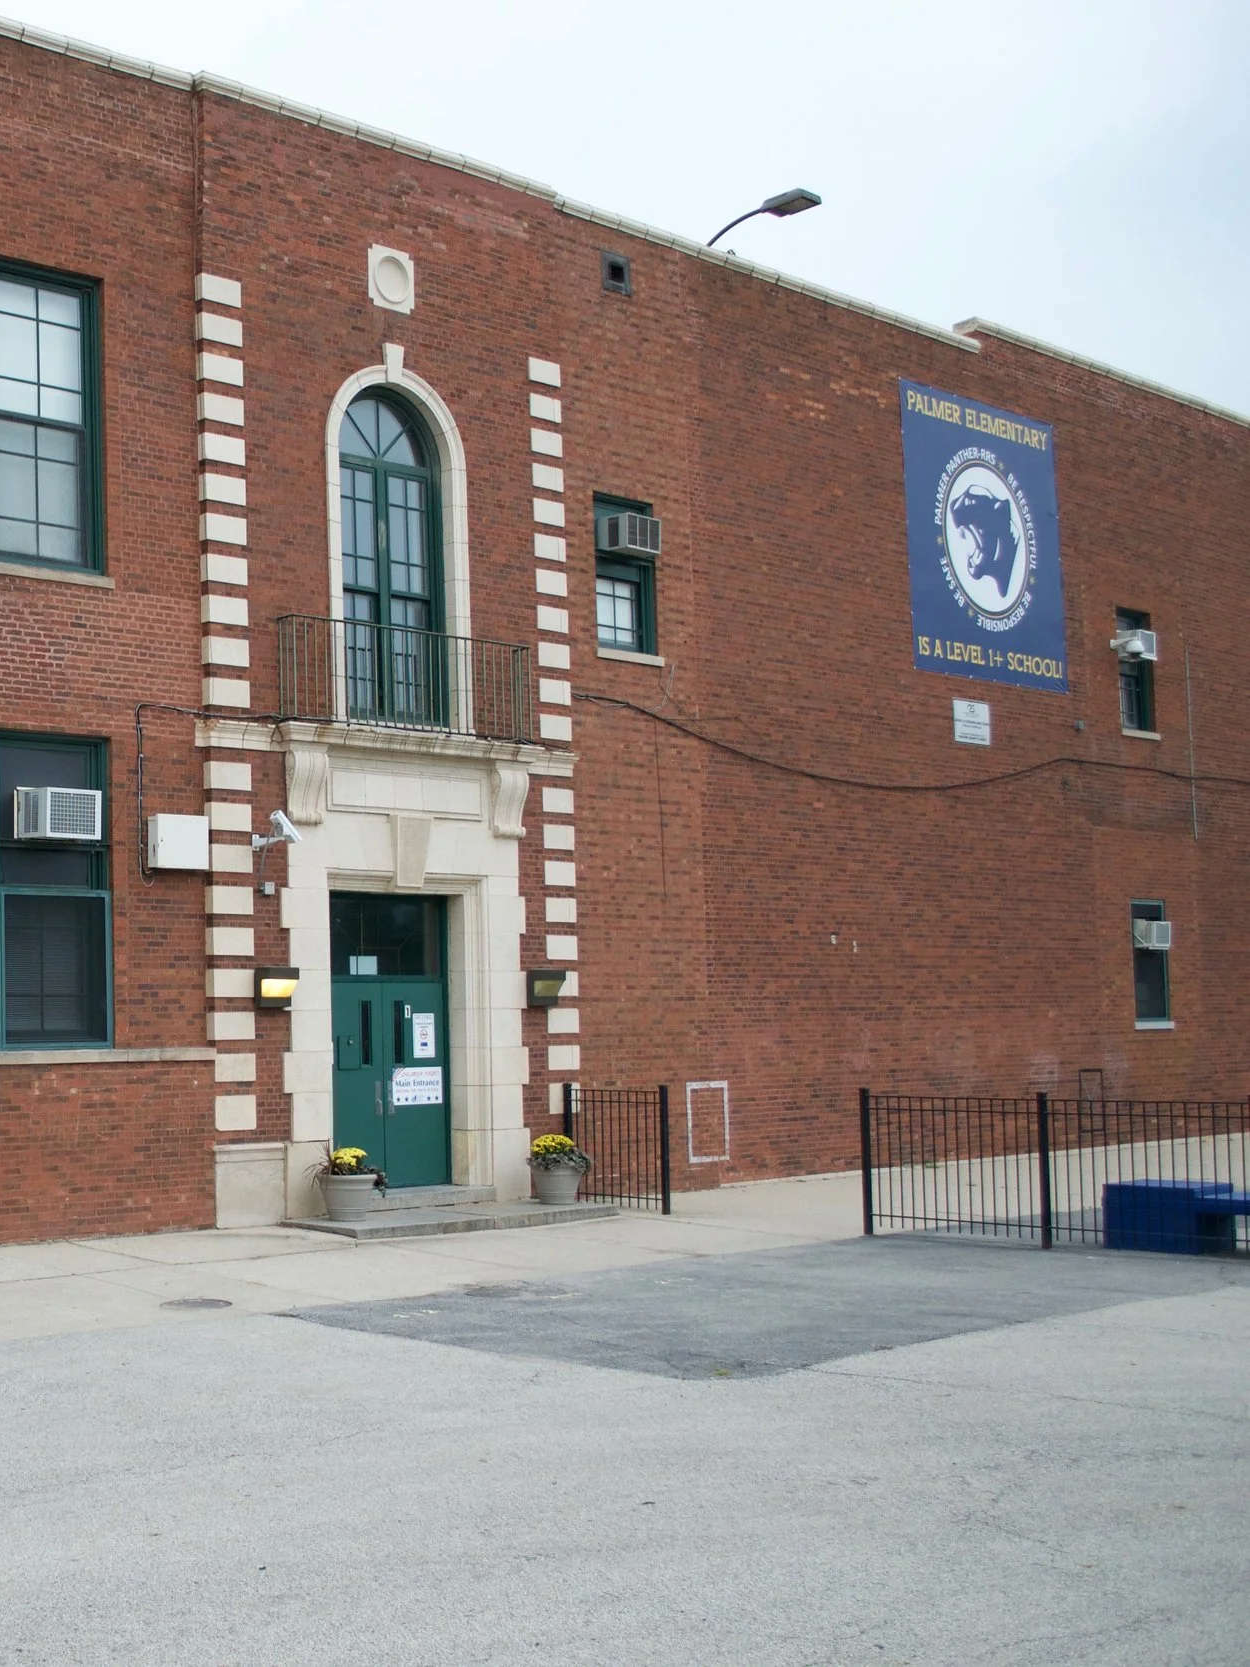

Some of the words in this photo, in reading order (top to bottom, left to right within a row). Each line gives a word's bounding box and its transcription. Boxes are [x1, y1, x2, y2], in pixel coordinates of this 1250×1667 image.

[906, 390, 962, 425] PALMER
[965, 408, 1048, 451] ELEMENTARY
[934, 472, 950, 526] PALMER
[1007, 473, 1019, 491] BE
[1015, 490, 1037, 570] RESPECTFUL
[939, 555, 956, 590] SAFE
[953, 589, 965, 608] BE
[1021, 590, 1032, 609] BE
[976, 605, 1026, 633] RESPONSIBLE
[918, 636, 930, 656] IS
[933, 639, 944, 659] A
[946, 641, 986, 666] LEVEL
[988, 648, 1004, 668] 1+
[1007, 651, 1063, 679] SCHOOL!
[395, 1079, 411, 1087] Main
[413, 1079, 440, 1087] Entrance
